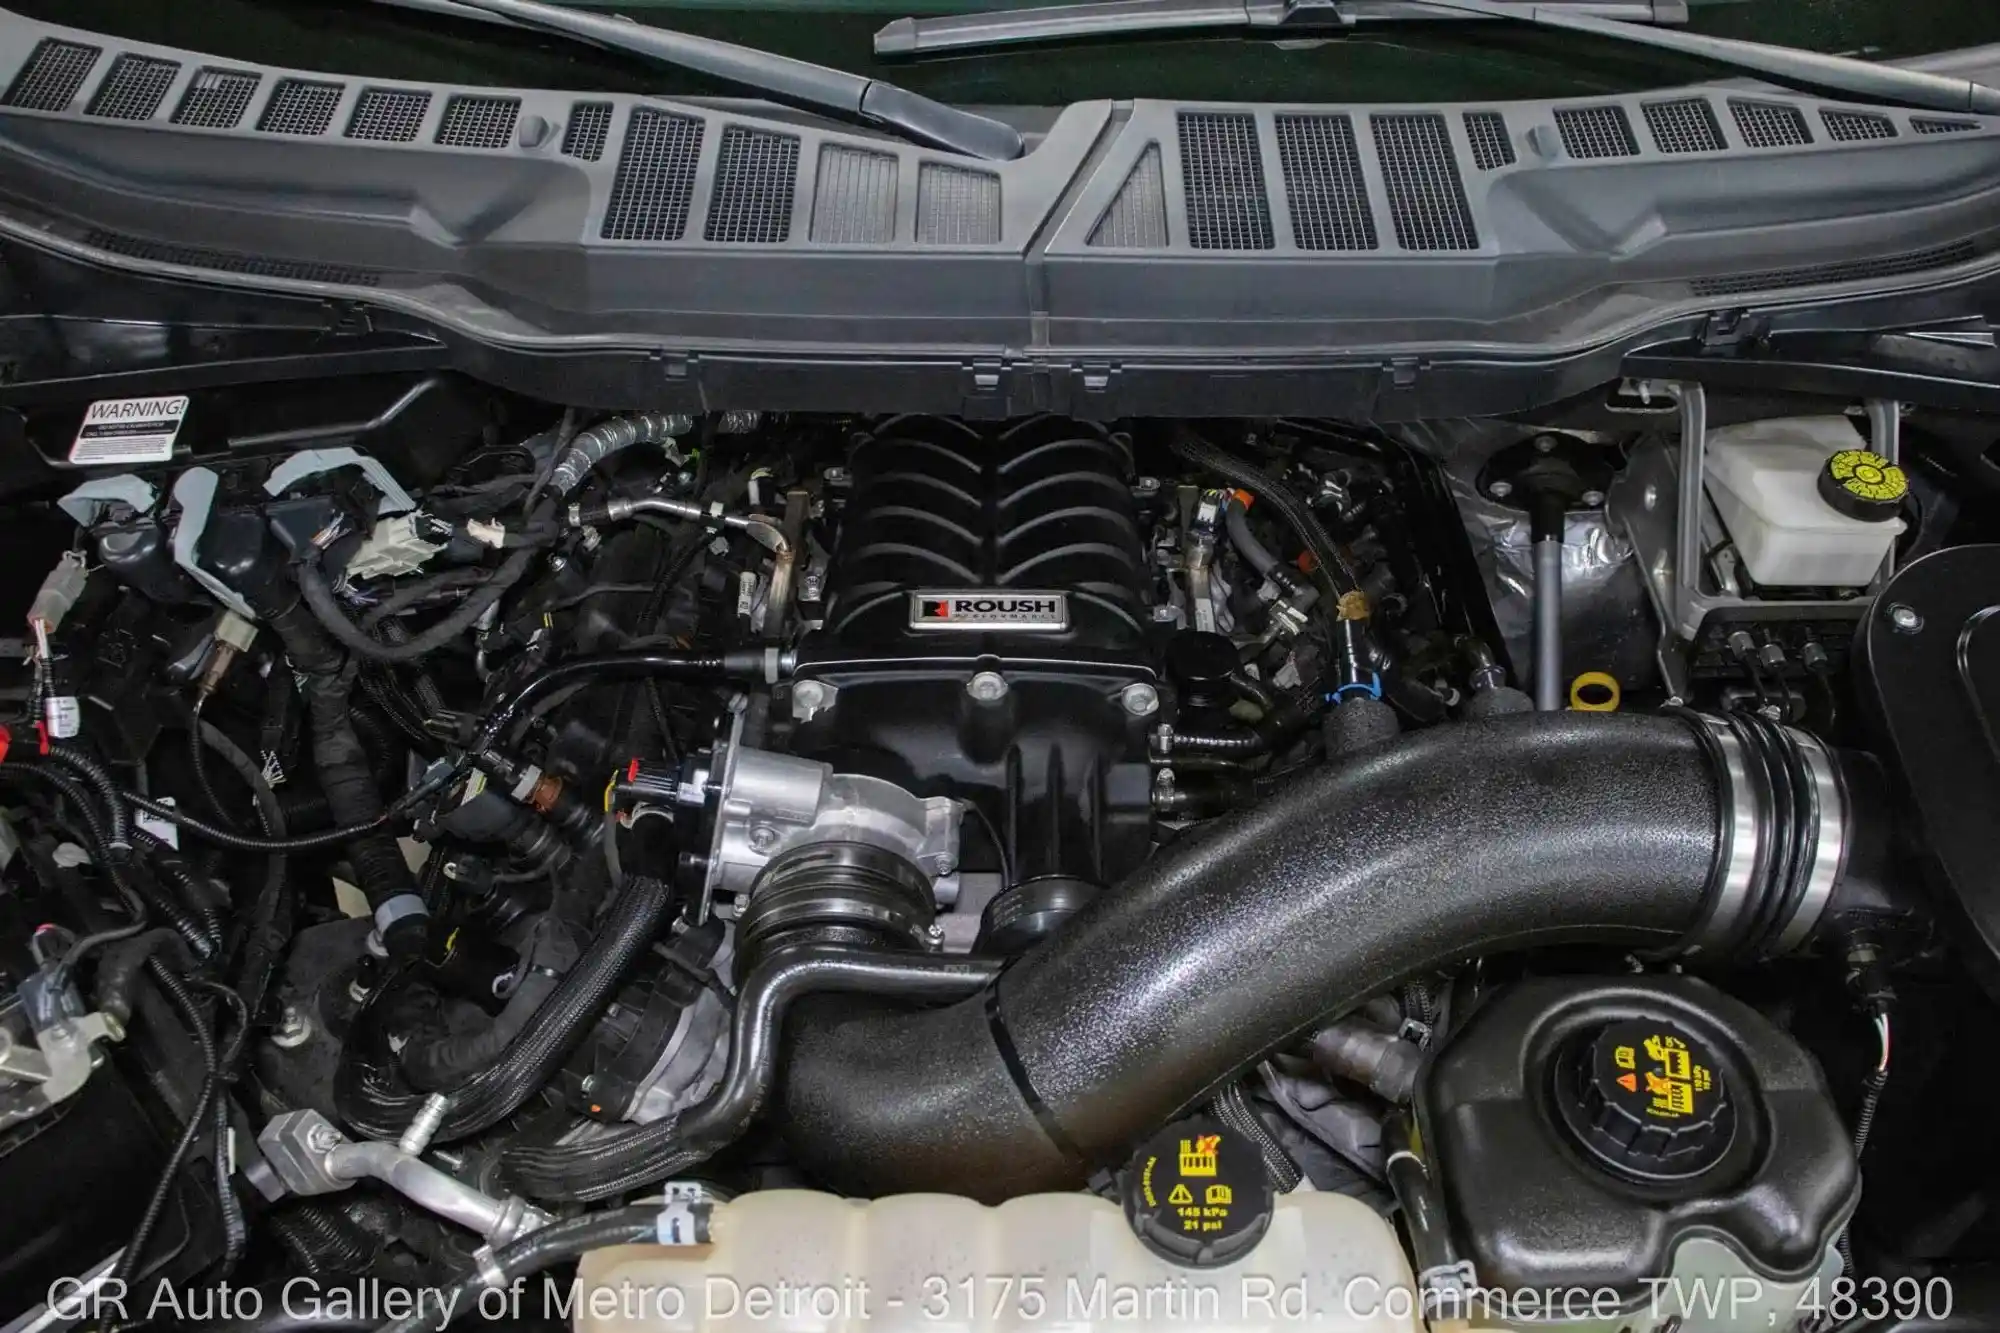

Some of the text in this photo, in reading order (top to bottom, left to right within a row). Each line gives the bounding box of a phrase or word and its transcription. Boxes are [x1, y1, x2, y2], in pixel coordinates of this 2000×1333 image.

[91, 399, 186, 419] WARNING!
[955, 600, 1056, 613] ROUSH
[1203, 1207, 1229, 1217] kPa
[1183, 1220, 1199, 1230] 21
